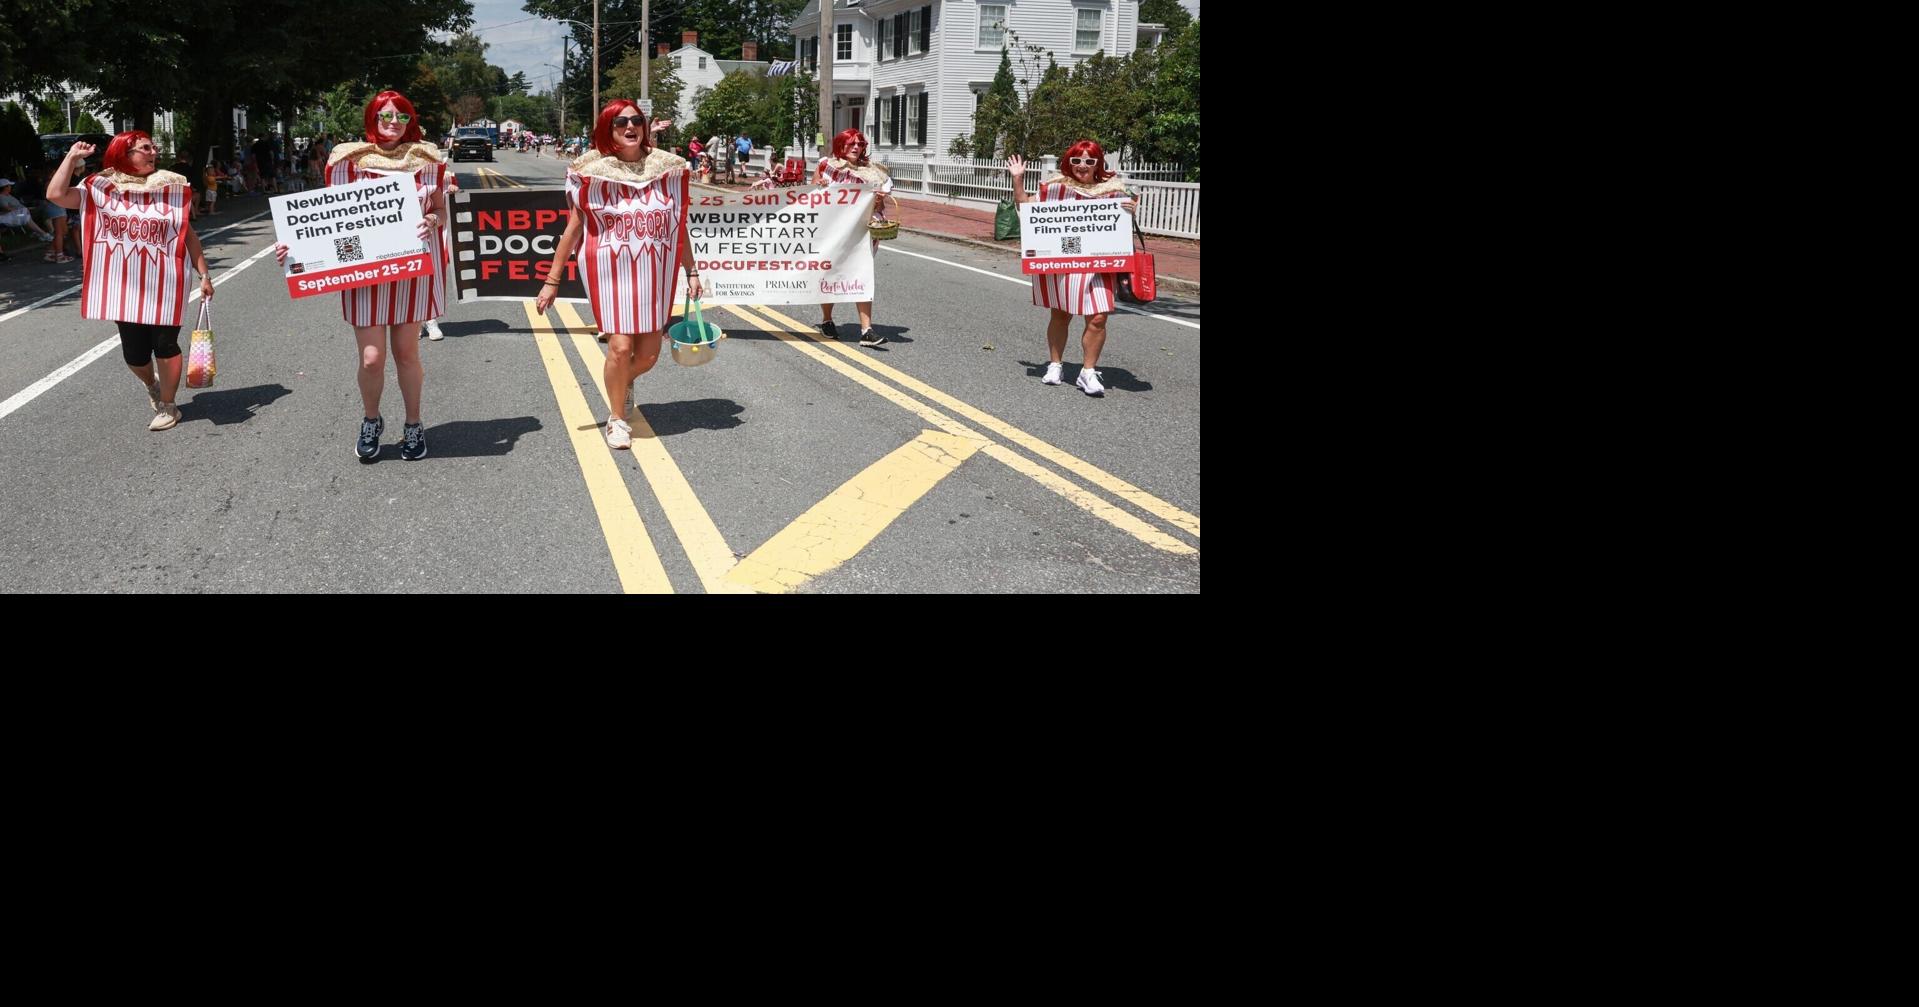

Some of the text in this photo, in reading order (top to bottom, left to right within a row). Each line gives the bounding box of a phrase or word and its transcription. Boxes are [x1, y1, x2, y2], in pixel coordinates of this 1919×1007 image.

[286, 181, 400, 211] Newburyport
[700, 195, 724, 207] 25
[742, 192, 780, 207] Sun
[786, 190, 832, 209] Sept
[837, 188, 862, 205] 27
[287, 197, 405, 226] Documentary
[1031, 201, 1118, 214] Newburyport
[687, 212, 819, 224] WBURYPORT
[1029, 213, 1121, 225] Documentary
[100, 211, 169, 247] POPCORN
[296, 211, 403, 240] Film Festival
[602, 208, 672, 242] POPCORN
[1034, 223, 1117, 234] Film Festival
[690, 226, 819, 239] CUMENTARY
[479, 235, 575, 255] DOC
[719, 242, 820, 255] FESTIVAL
[481, 260, 578, 281] FEST
[696, 260, 832, 271] DOCUFEST.ORG
[1029, 260, 1091, 271] September
[298, 268, 380, 292] September
[715, 281, 755, 290] INSTITUTION
[765, 280, 809, 290] PRIMARY
[729, 289, 755, 297] SAVINGS
